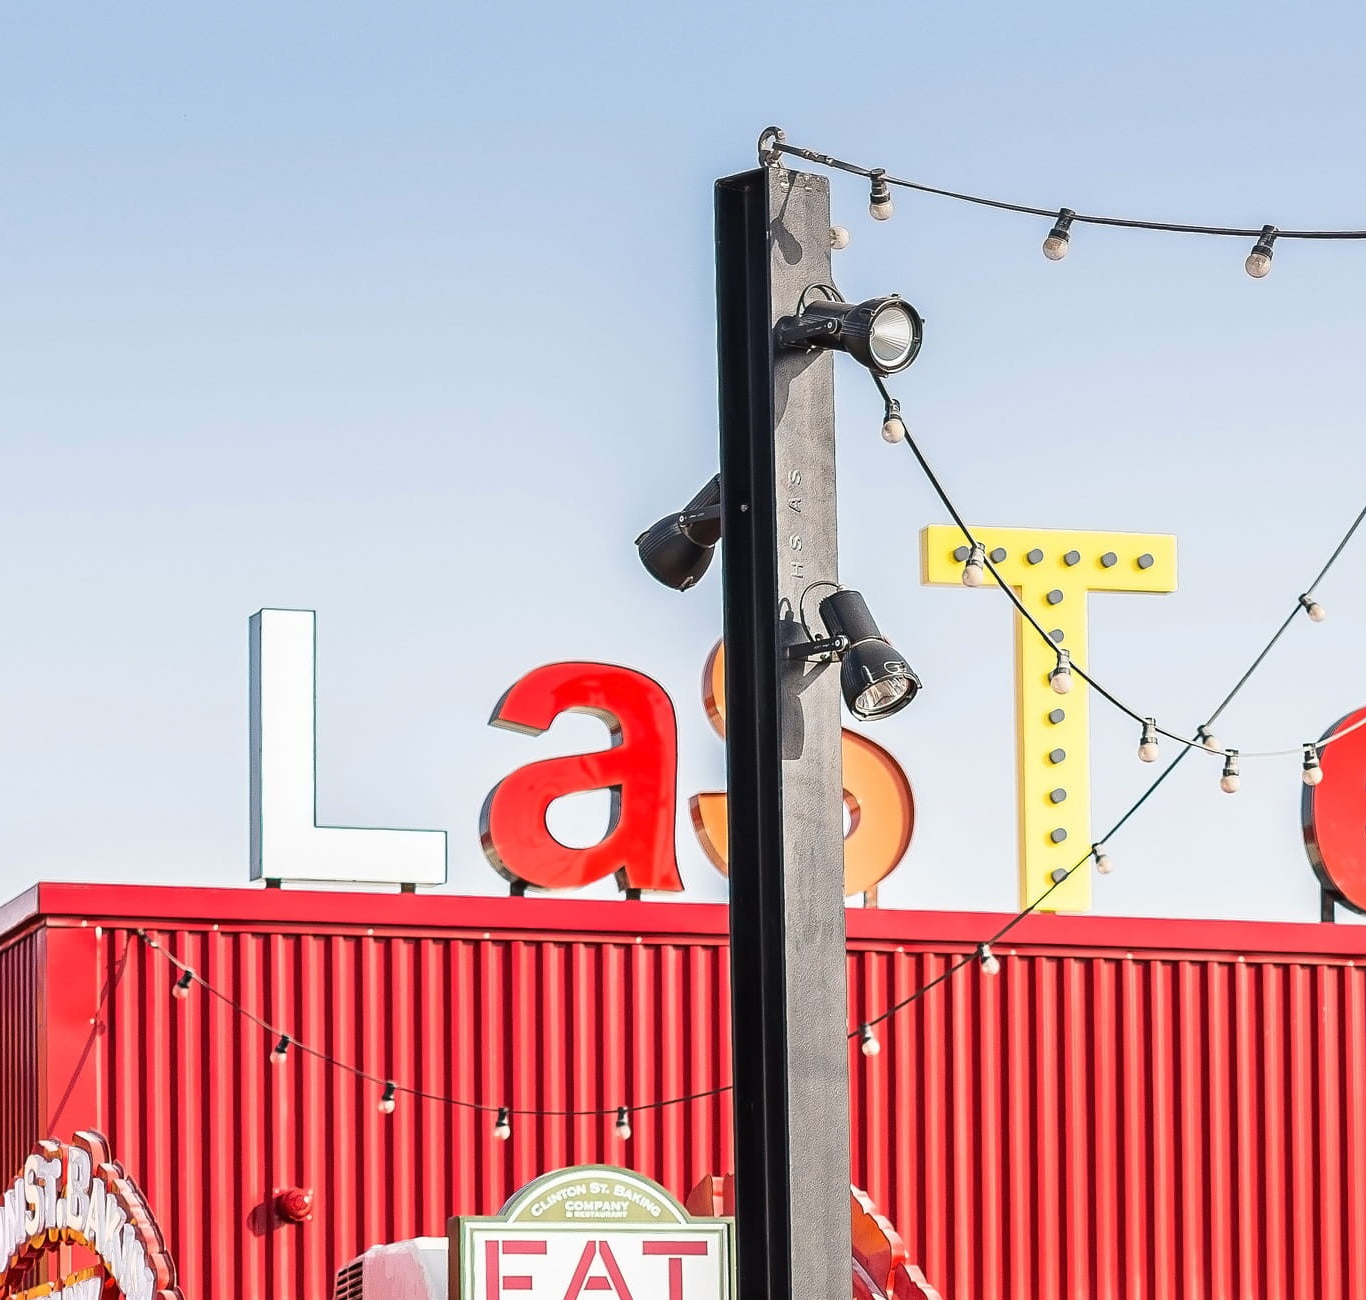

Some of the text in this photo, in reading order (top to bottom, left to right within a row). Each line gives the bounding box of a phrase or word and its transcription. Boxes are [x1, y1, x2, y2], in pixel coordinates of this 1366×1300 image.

[530, 1184, 587, 1217] CLINTON
[613, 1184, 662, 1217] BAKING
[564, 1200, 630, 1211] COMPANY
